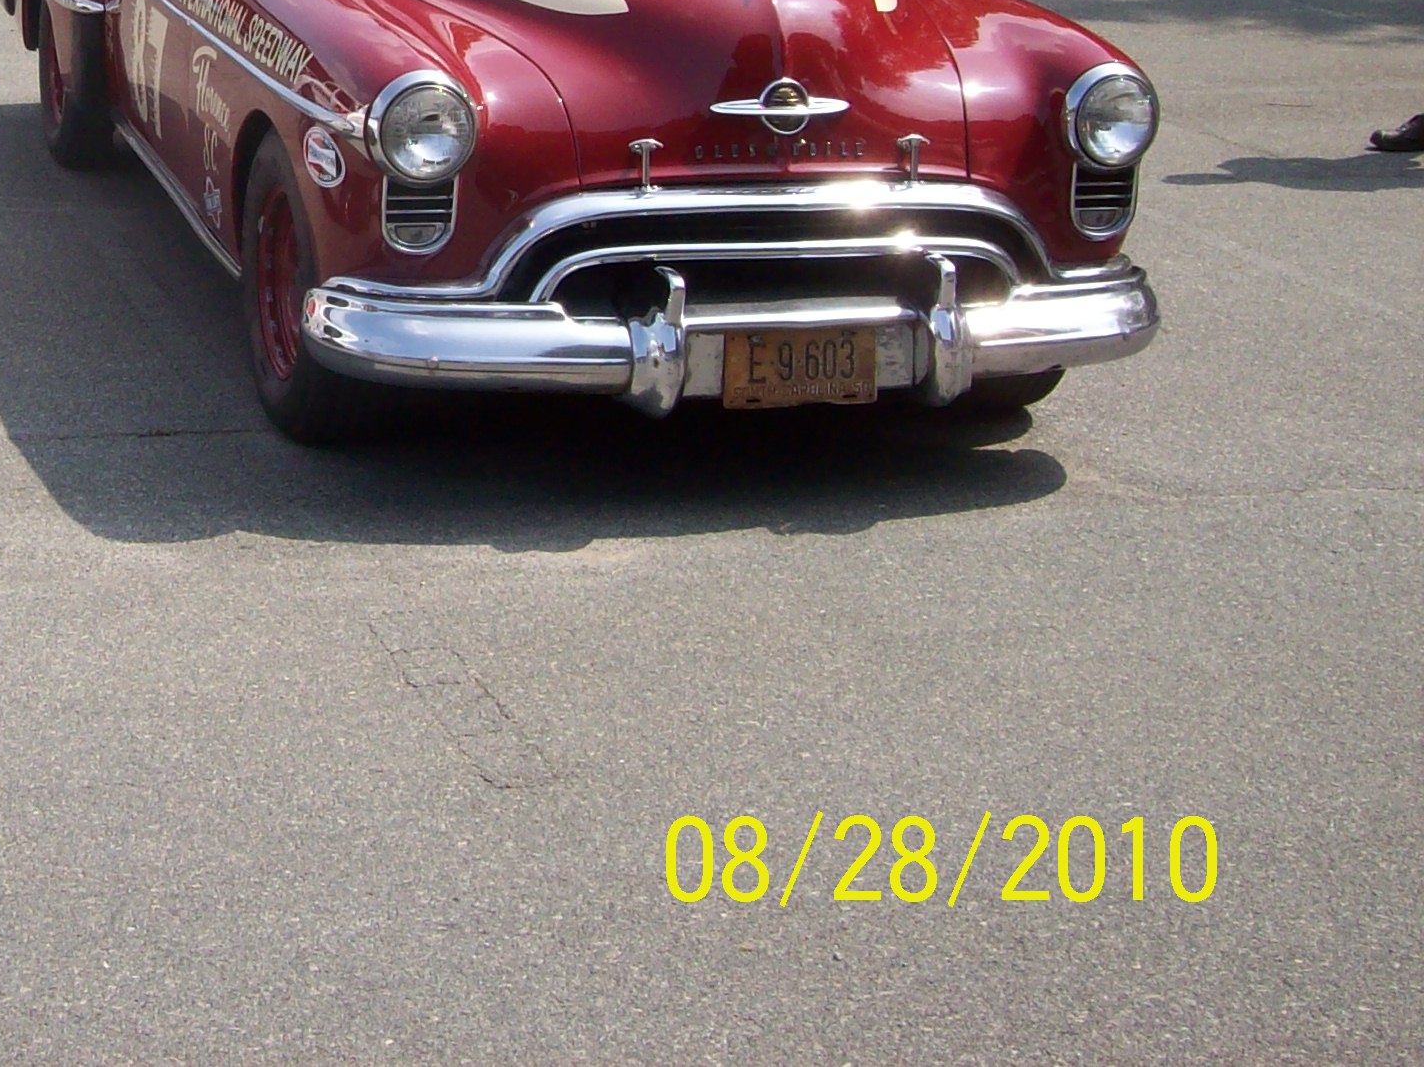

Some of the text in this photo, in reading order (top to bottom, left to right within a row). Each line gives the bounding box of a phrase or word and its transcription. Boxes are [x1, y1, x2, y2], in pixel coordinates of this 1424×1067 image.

[243, 13, 314, 85] SPEEDWAY
[694, 139, 865, 160] OLDSMOBILE
[783, 383, 847, 398] CAROLINA
